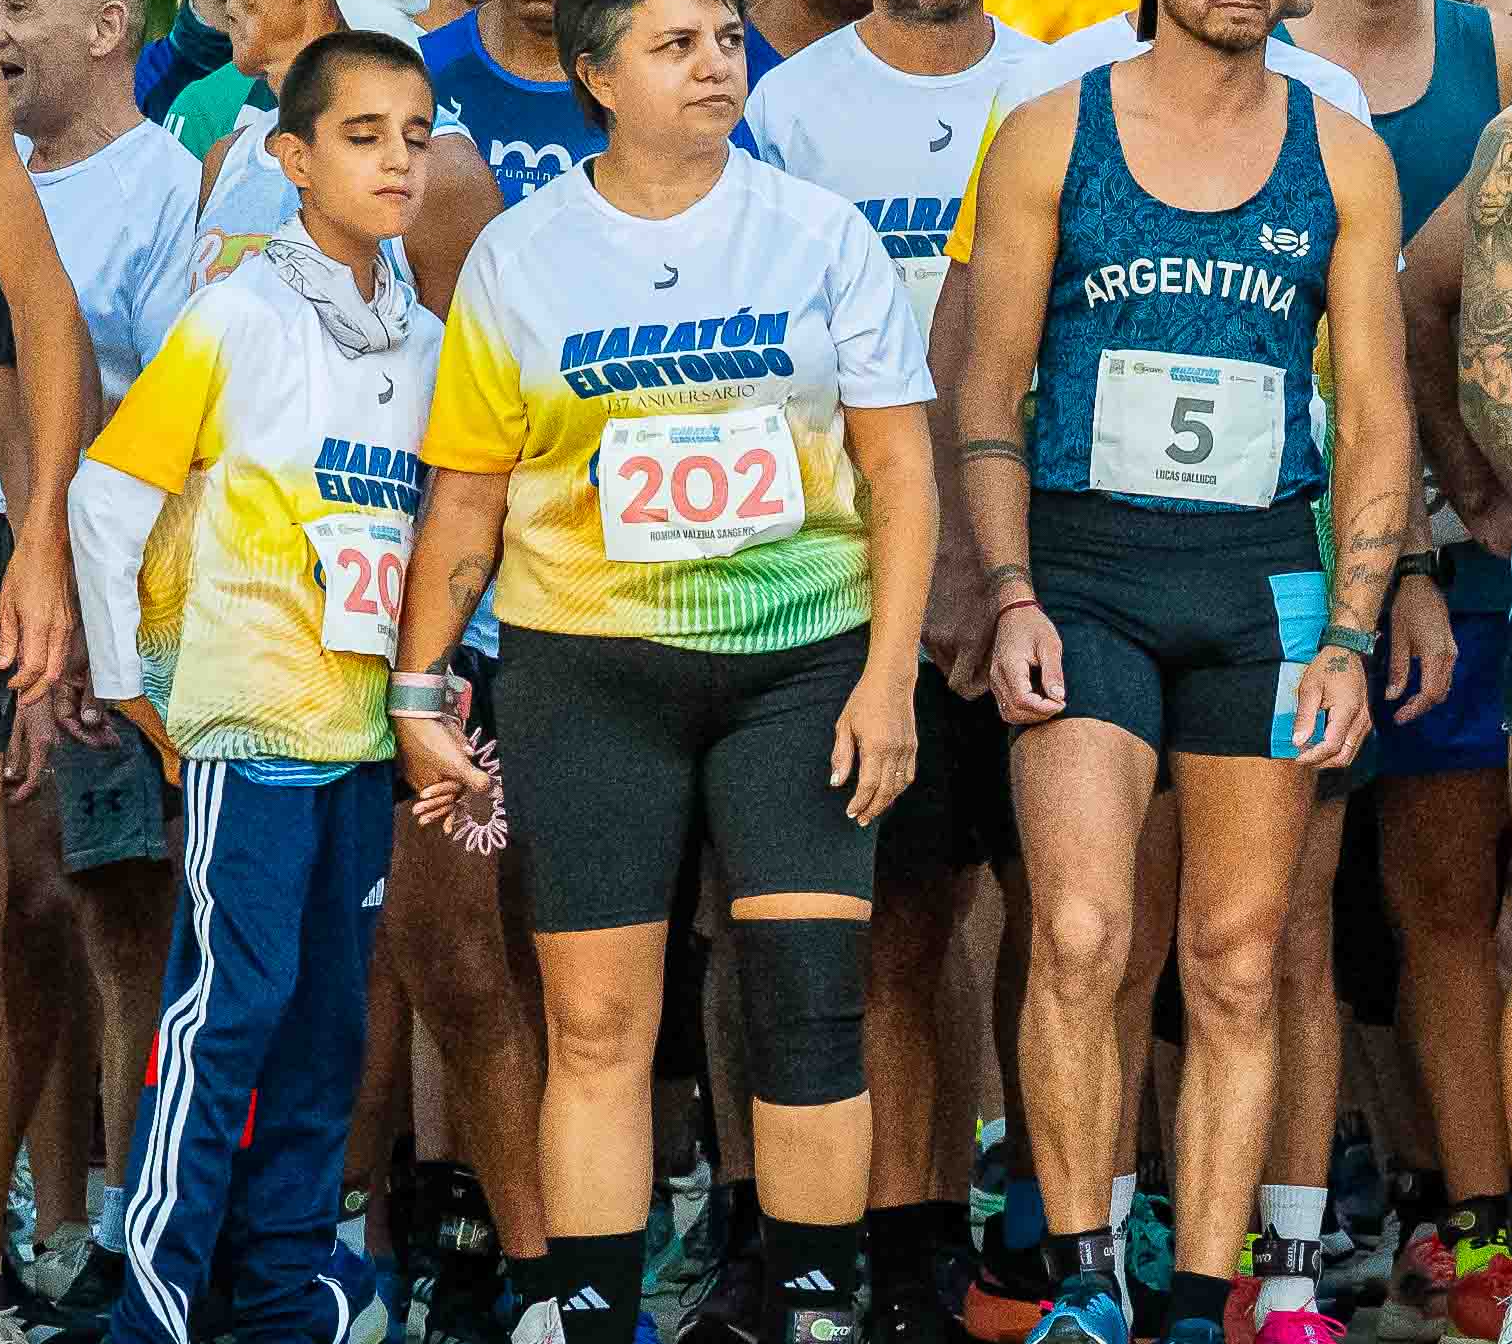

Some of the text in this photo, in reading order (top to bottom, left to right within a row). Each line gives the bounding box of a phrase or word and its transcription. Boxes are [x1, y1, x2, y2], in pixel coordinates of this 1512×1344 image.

[495, 167, 552, 181] runnin
[1084, 256, 1297, 321] ARGENTINA
[559, 307, 790, 374] MARATÓN
[561, 350, 794, 399] ELORTONDO
[637, 383, 756, 410] ANIVERSARIO
[1164, 396, 1215, 465] 5
[315, 436, 419, 488] MARAT
[617, 448, 785, 524] 202
[1156, 469, 1180, 482] LUCAS
[315, 471, 421, 515] ELORTO
[337, 548, 405, 624] 20
